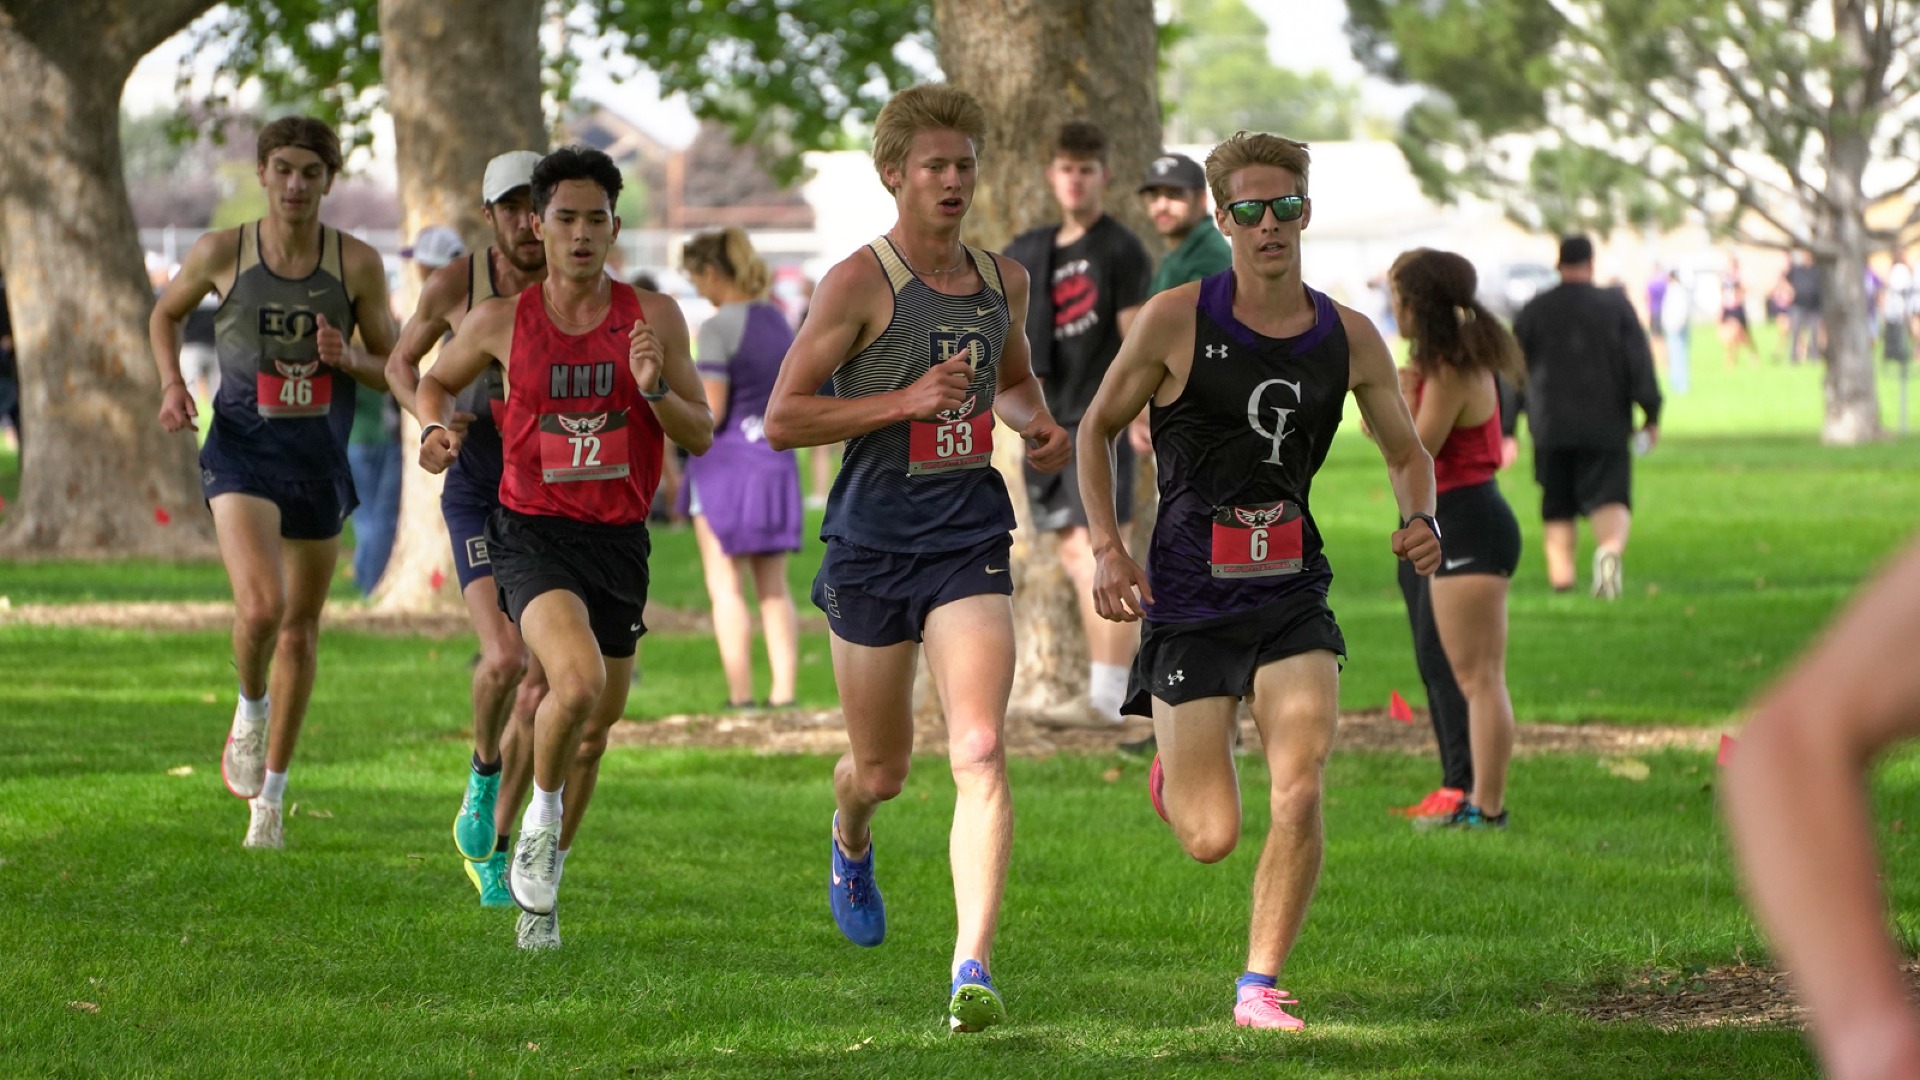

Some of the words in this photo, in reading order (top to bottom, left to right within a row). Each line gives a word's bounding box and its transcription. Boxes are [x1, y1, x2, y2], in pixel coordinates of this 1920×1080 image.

[280, 379, 312, 406] 46
[550, 362, 615, 398] NNU
[568, 436, 601, 468] 72
[936, 421, 973, 458] 53
[1250, 529, 1269, 562] 6
